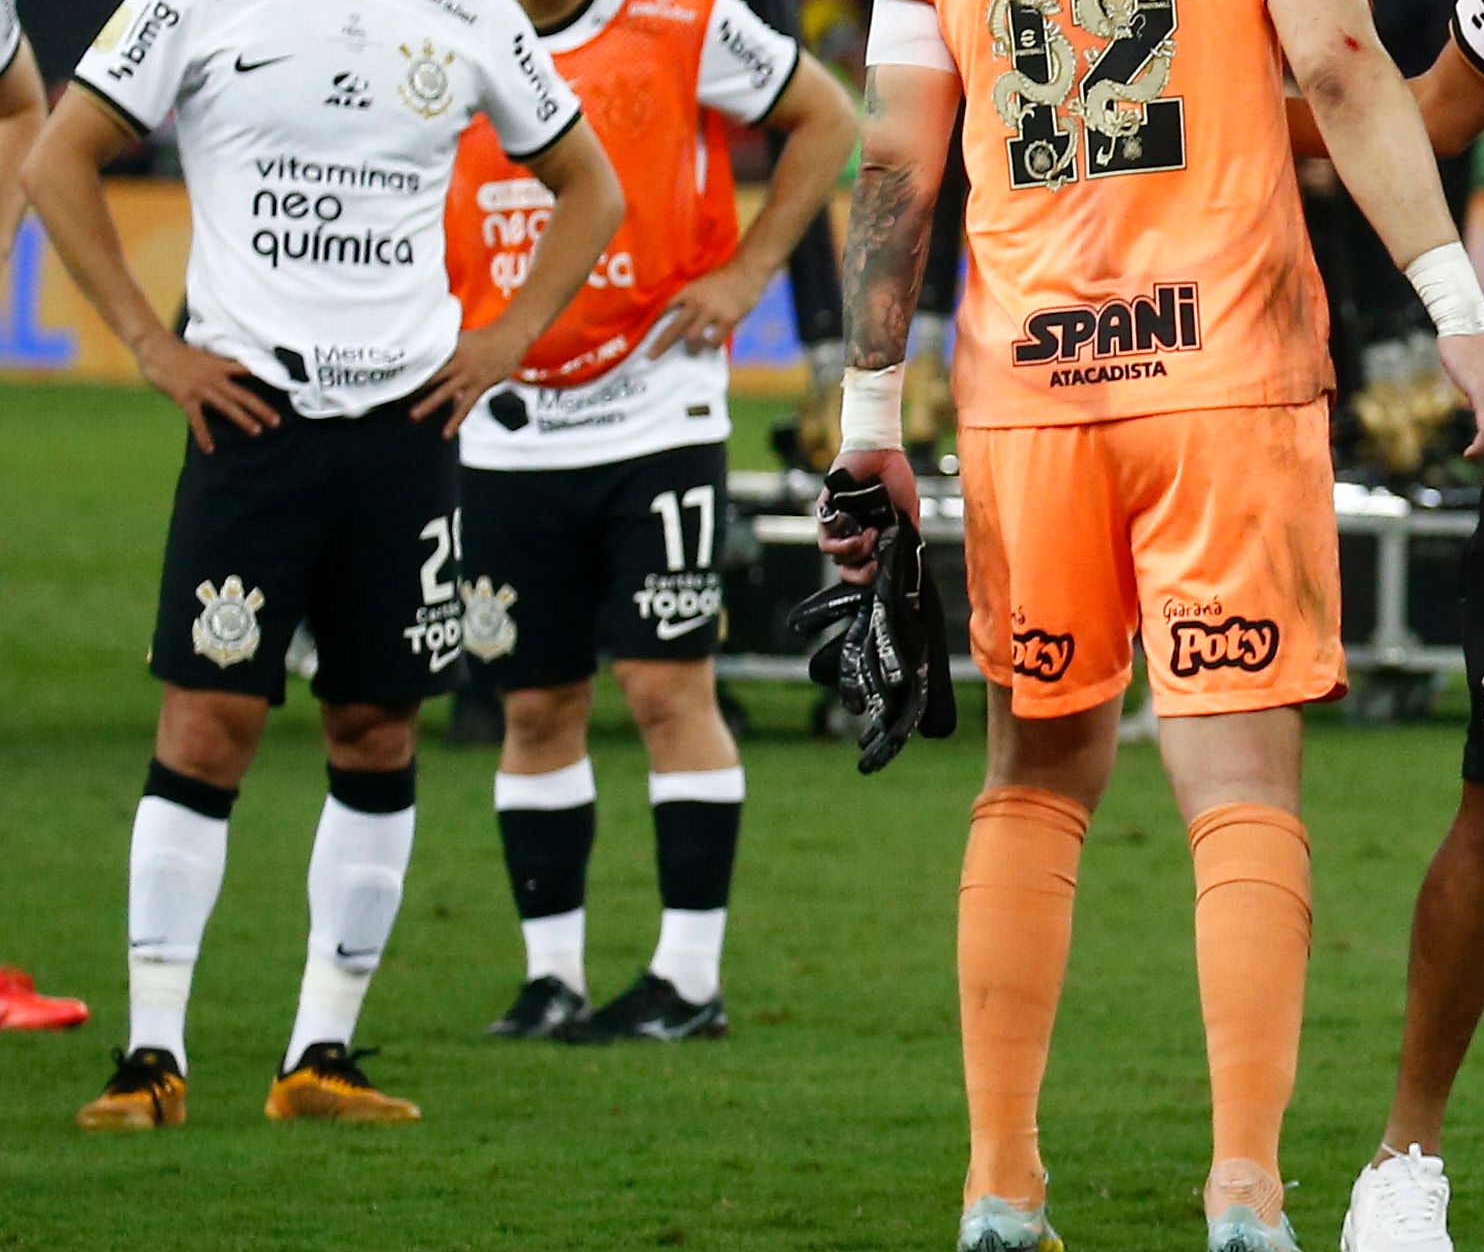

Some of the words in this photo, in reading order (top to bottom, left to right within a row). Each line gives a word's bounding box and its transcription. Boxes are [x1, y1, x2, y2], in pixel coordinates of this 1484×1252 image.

[121, 0, 180, 66] bmg
[256, 154, 421, 194] vitaminas
[252, 190, 343, 221] neo
[252, 222, 414, 268] química
[1050, 361, 1168, 389] ATACADISTA
[650, 484, 716, 571] 17
[1162, 597, 1223, 623] Guaraná
[403, 617, 461, 654] TOD
[1012, 629, 1075, 682] oty
[1170, 616, 1280, 677] Poty
